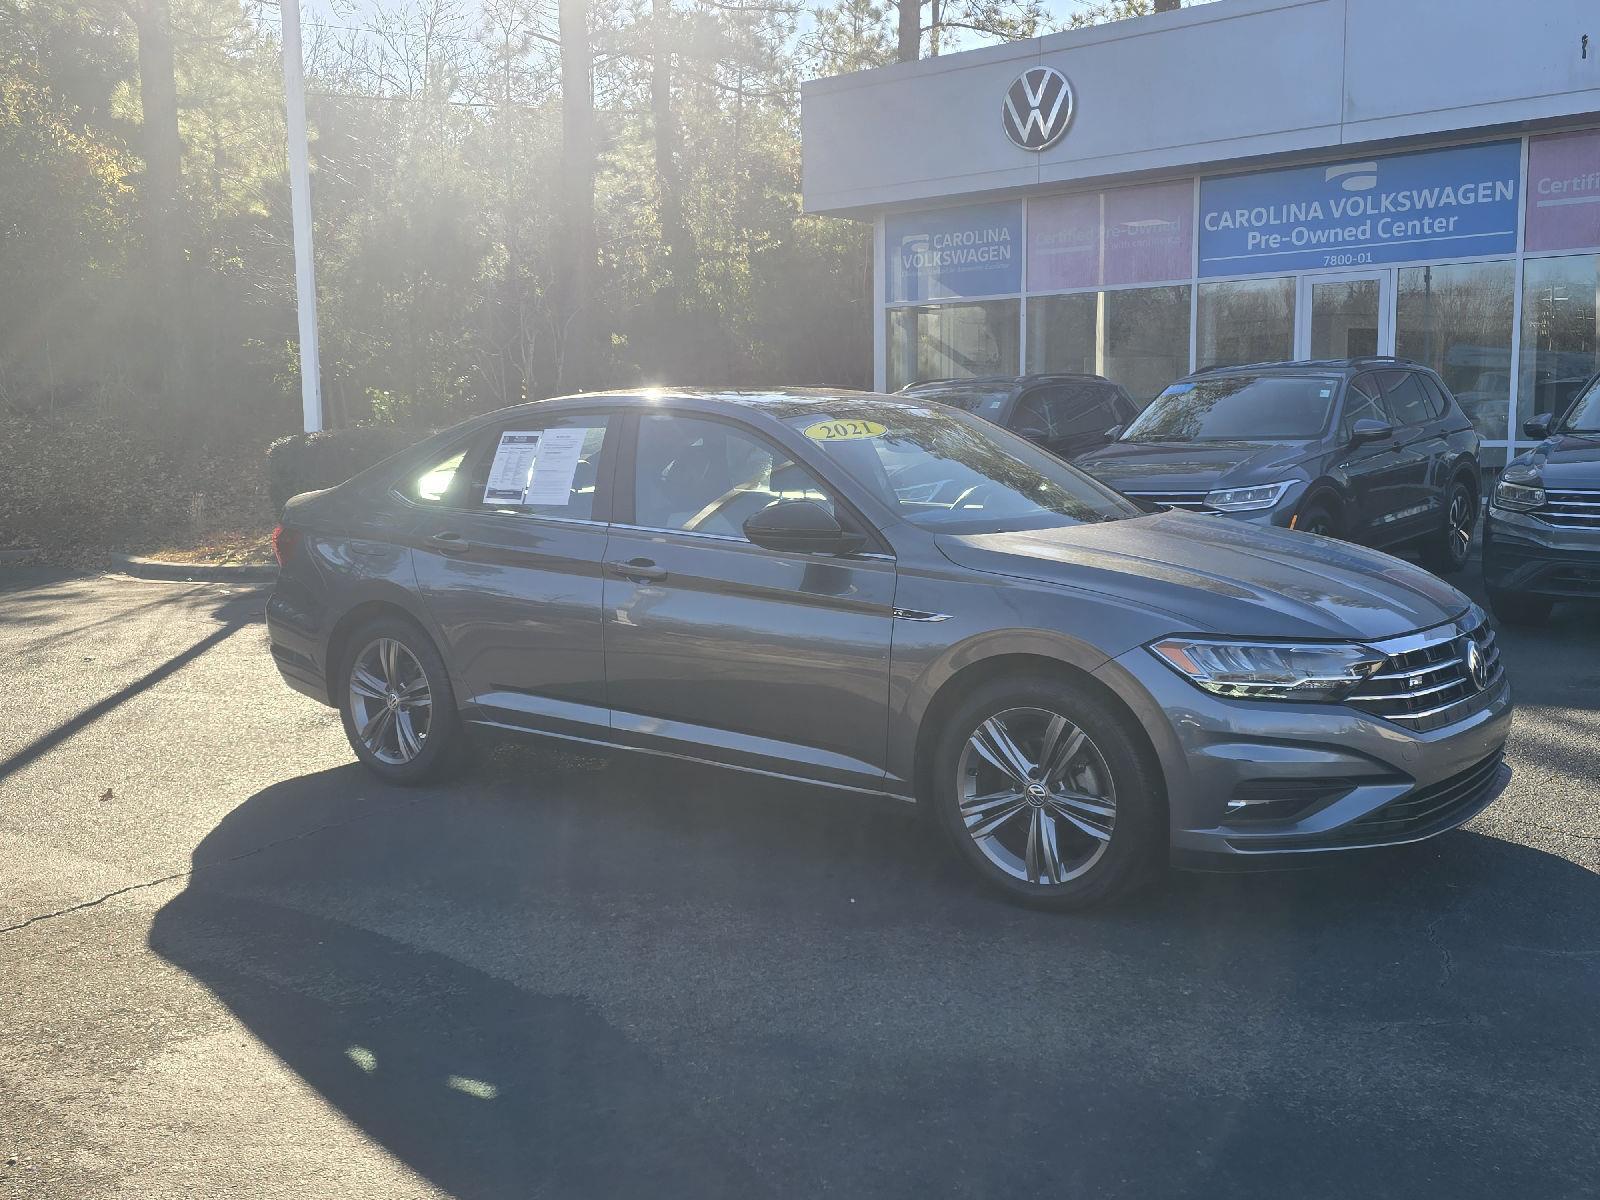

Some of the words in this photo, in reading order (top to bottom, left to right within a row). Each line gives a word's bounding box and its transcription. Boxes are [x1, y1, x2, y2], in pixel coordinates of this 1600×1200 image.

[1204, 201, 1319, 231] CAROLINA
[1329, 179, 1514, 218] VOLKSWAGEN
[933, 227, 1011, 249] CAROLINA
[1247, 220, 1371, 250] Pre-Owned
[1377, 216, 1458, 238] Center
[902, 245, 1012, 270] VOLKSWAGEN
[1323, 252, 1373, 267] 7800-01
[819, 422, 876, 439] 2021
